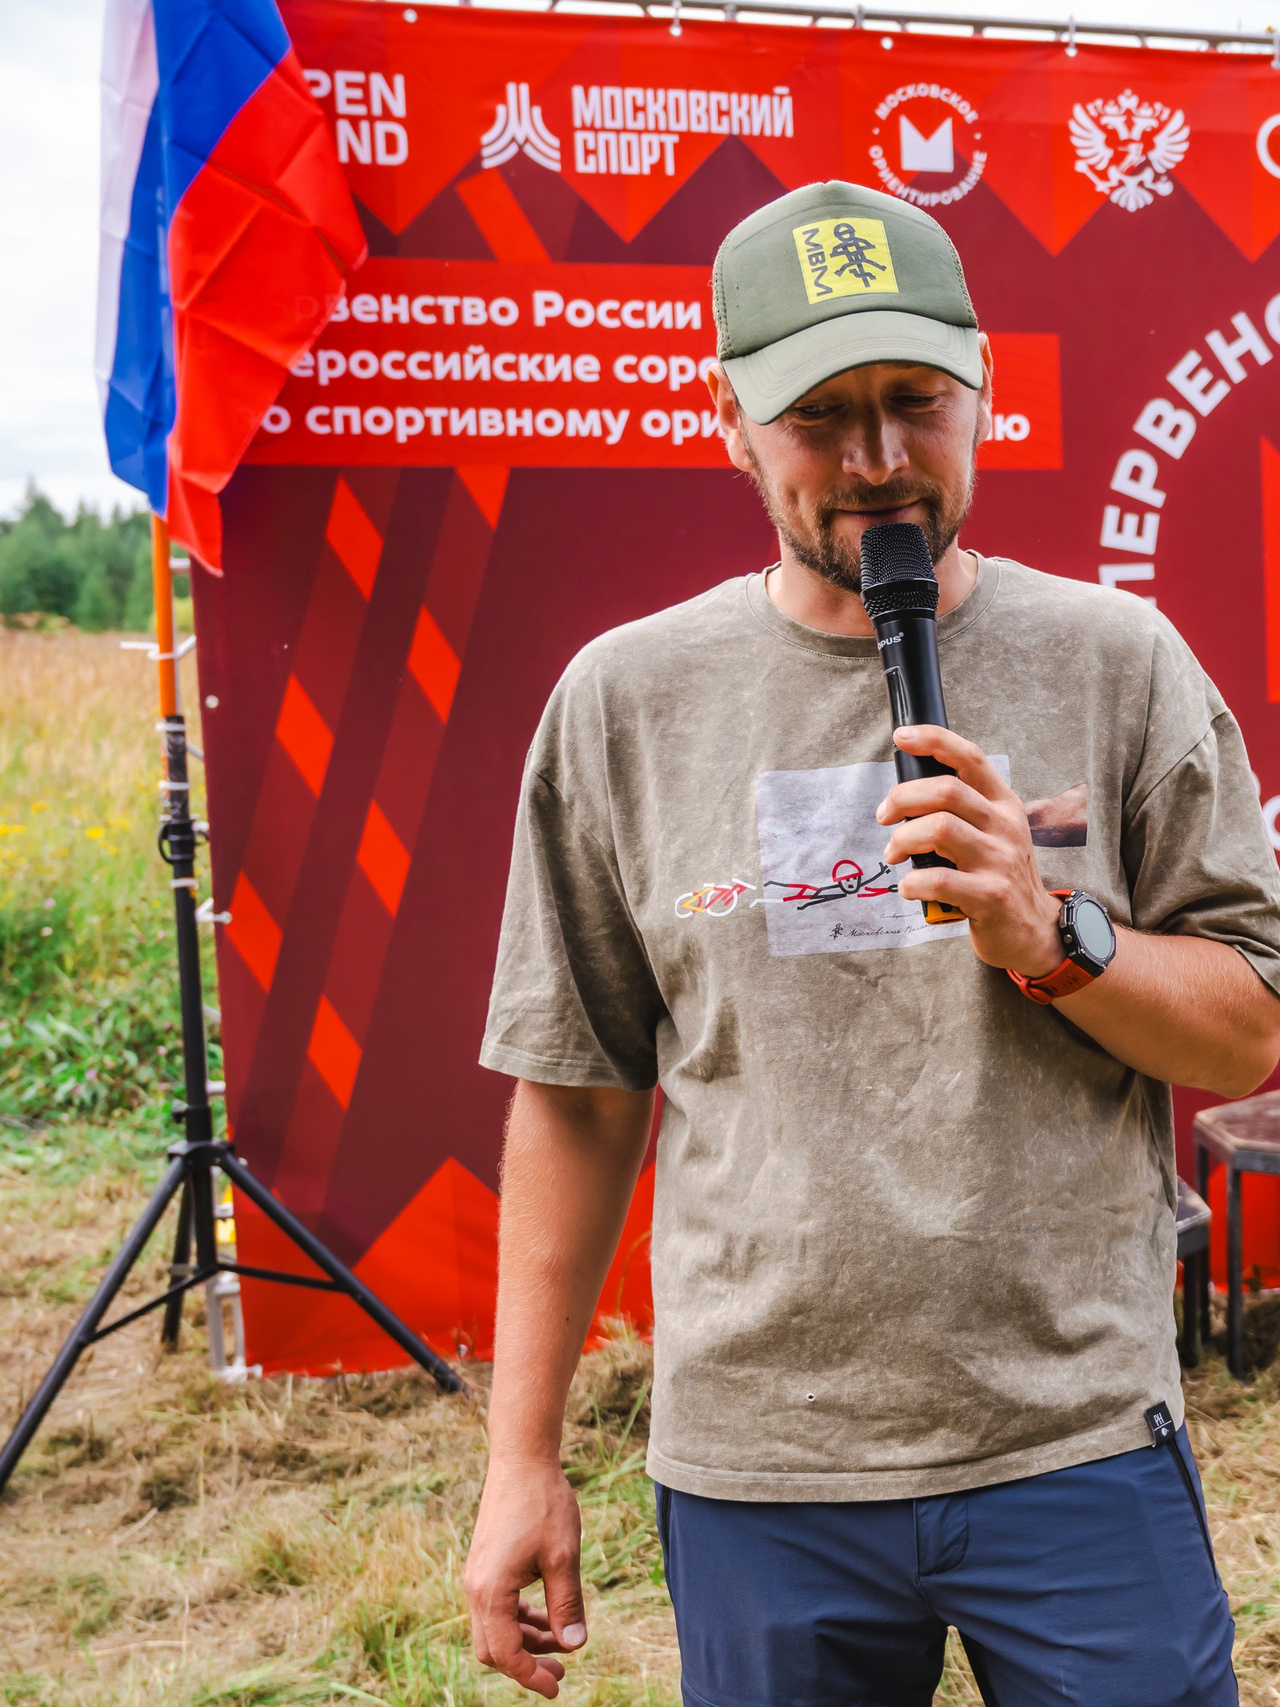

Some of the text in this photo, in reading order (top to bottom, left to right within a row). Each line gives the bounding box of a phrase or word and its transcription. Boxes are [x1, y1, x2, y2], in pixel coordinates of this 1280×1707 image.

[302, 69, 408, 118] PEN
[571, 86, 794, 138] МОСКОВСКИЙ
[874, 82, 979, 124] МОСКОВСКОЕ
[335, 118, 409, 166] ND
[573, 132, 681, 176] СПОРТ
[868, 144, 988, 207] ОРИЕНТИРОВАНИЕ
[328, 290, 703, 330] венство России
[290, 344, 601, 386] ероссийские
[261, 405, 292, 434] о
[304, 405, 630, 445] спортивному
